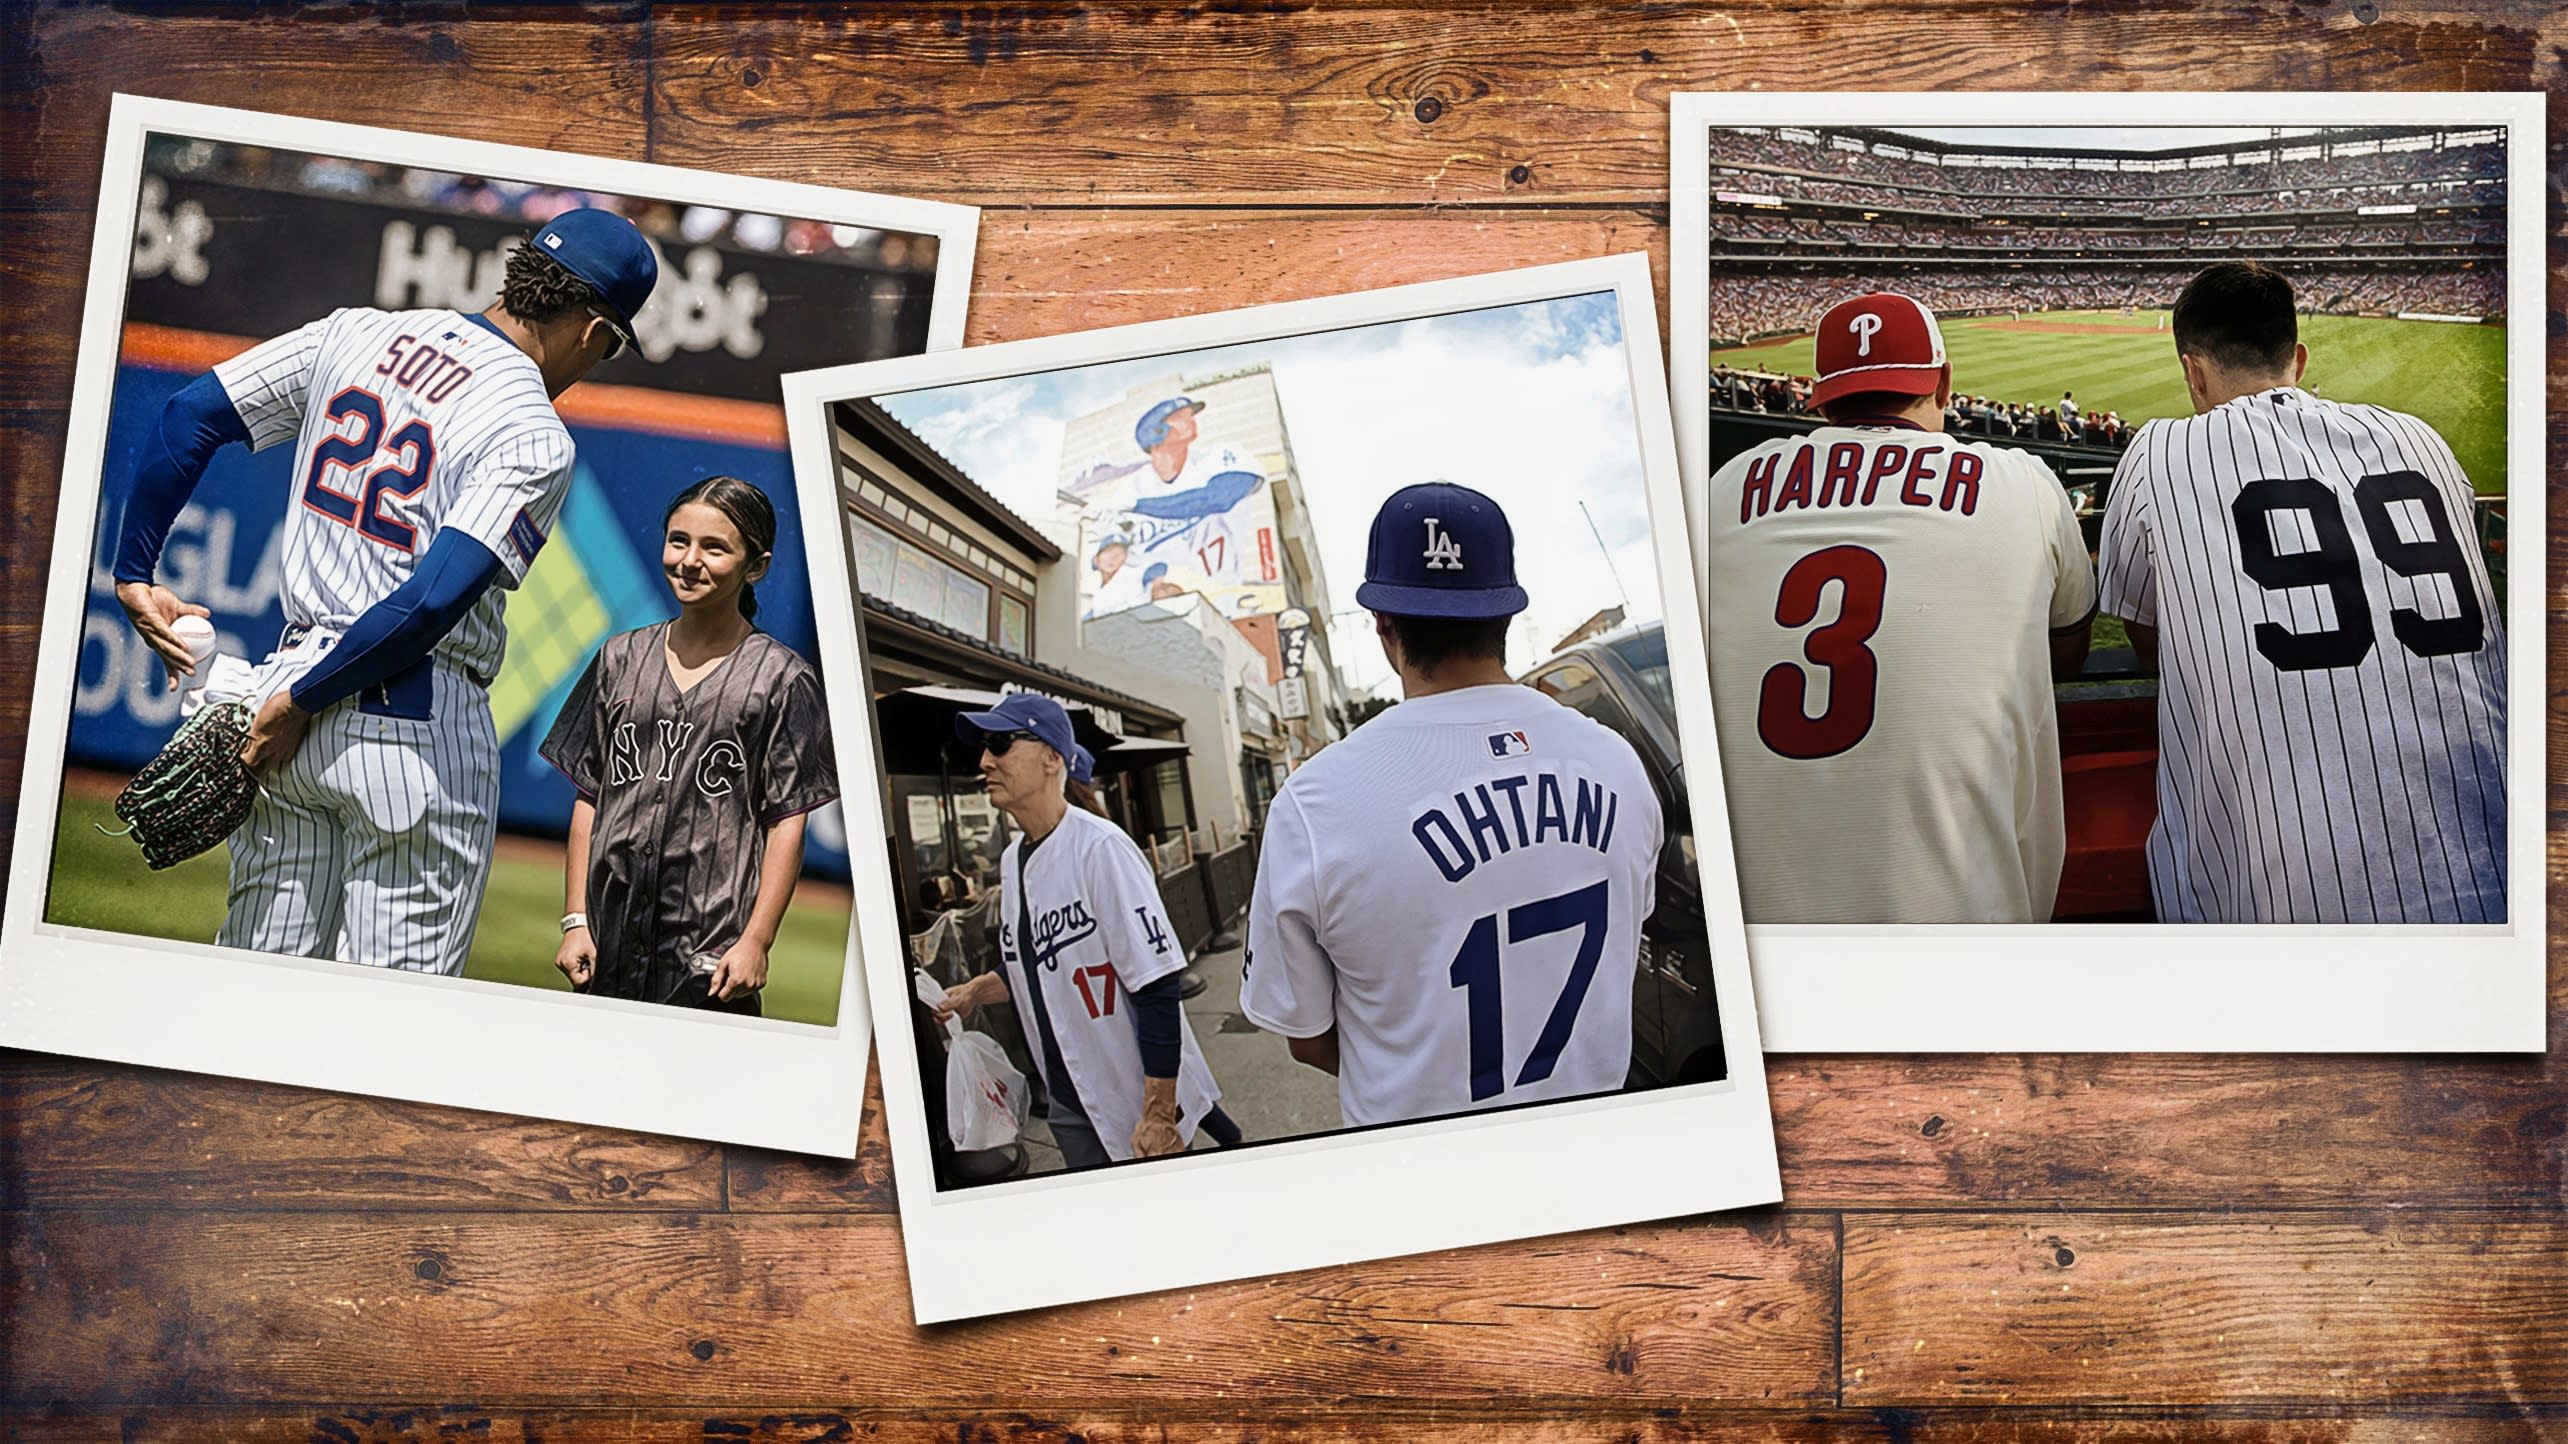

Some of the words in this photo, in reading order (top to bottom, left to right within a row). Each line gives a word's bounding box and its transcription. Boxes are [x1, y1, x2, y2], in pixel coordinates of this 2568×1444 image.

[376, 334, 472, 404] SOTO
[1848, 313, 1882, 357] P
[303, 385, 437, 554] 22
[1740, 442, 1983, 524] HARPER
[1197, 535, 1225, 577] 17
[1423, 518, 1464, 570] LA
[2232, 470, 2485, 672] 99
[1757, 544, 1887, 760] 3
[609, 719, 746, 798] NYC
[1412, 773, 1618, 883] OHTANI
[1134, 906, 1172, 955] LA
[1072, 961, 1117, 1020] 17
[1449, 879, 1609, 1103] 17
